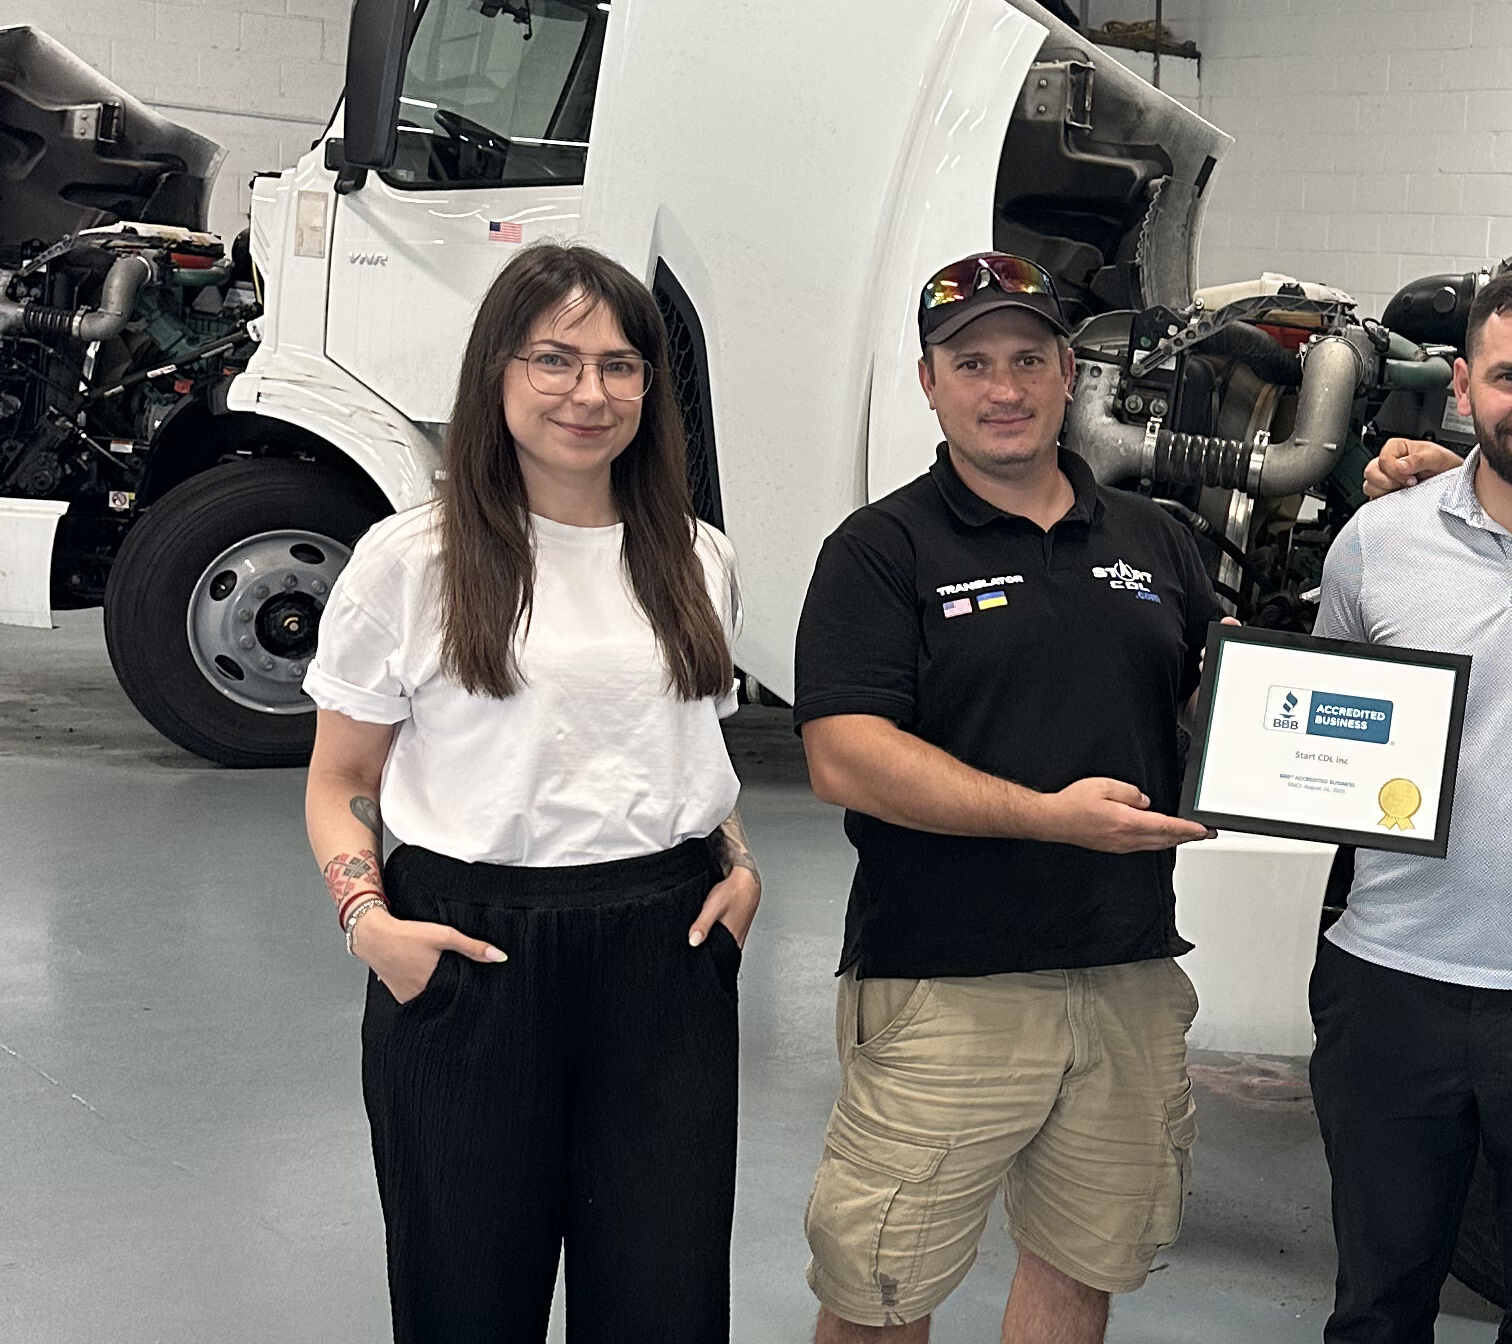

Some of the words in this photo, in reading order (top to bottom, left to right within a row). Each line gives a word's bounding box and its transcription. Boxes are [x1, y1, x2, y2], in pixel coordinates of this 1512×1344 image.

[936, 575, 1024, 596] TRANSLATOR
[1110, 581, 1151, 592] CDL
[1316, 704, 1386, 721] ACCREDITED
[1273, 718, 1299, 730] BBB
[1314, 715, 1368, 730] BUSINESS
[1295, 751, 1316, 761] Start
